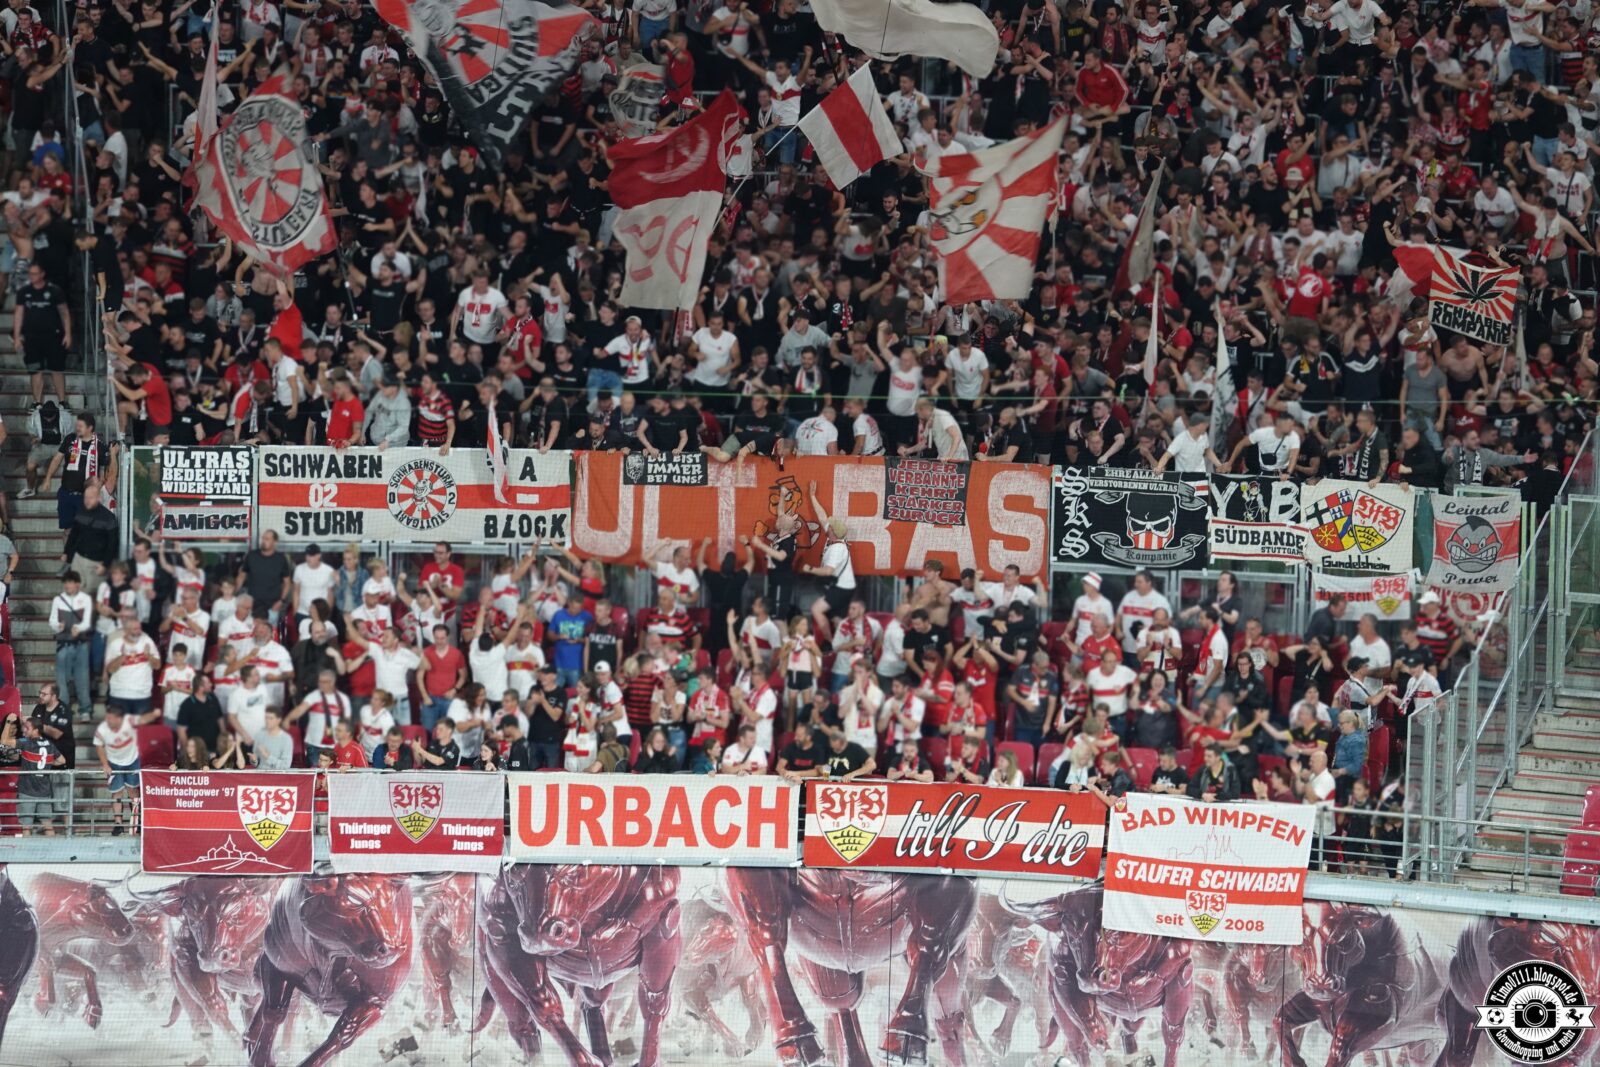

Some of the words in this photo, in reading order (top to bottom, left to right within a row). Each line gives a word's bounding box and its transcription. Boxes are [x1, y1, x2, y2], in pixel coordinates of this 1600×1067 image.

[163, 451, 250, 469] ULTRAS
[264, 453, 383, 478] SCHWABEN
[897, 459, 957, 474] JEDER
[163, 467, 250, 483] BEDEUTET
[389, 459, 455, 489] SCHWABENSTURM
[518, 456, 538, 482] A
[647, 463, 703, 475] IMMER
[1104, 468, 1132, 478] EHRE
[647, 474, 668, 483] BEI
[672, 475, 704, 484] UNS!
[888, 468, 966, 488] VERBANNTE
[1089, 479, 1149, 490] VERSTORBENEN
[1149, 482, 1178, 492] ULTRAS
[161, 481, 251, 495] WIDERSTAND
[308, 483, 338, 508] 02
[895, 484, 958, 499] KEHRT
[1441, 500, 1510, 515] Leintal
[284, 510, 364, 536] STURM
[394, 509, 450, 530] STUTTGART
[484, 513, 567, 538] BLOCK
[1214, 526, 1305, 550] SÜDBANDE
[1441, 572, 1500, 585] Power
[170, 776, 210, 786] FANCLUB
[145, 785, 220, 798] Schlierbachpower
[176, 798, 204, 808] Neuler
[517, 783, 791, 849] URBACH
[338, 822, 392, 836] Thüringer
[441, 823, 496, 837] Thüringer
[895, 790, 981, 857] till
[964, 800, 1030, 862] I
[1020, 803, 1089, 867] die
[1121, 807, 1176, 832] BAD
[1183, 806, 1307, 847] WIMPFEN
[350, 838, 382, 850] Jungs
[452, 839, 485, 852] Jungs
[1114, 858, 1194, 887] STAUFER
[1198, 869, 1300, 893] SCHWABEN
[1156, 913, 1184, 927] seit
[1224, 918, 1265, 932] 2008
